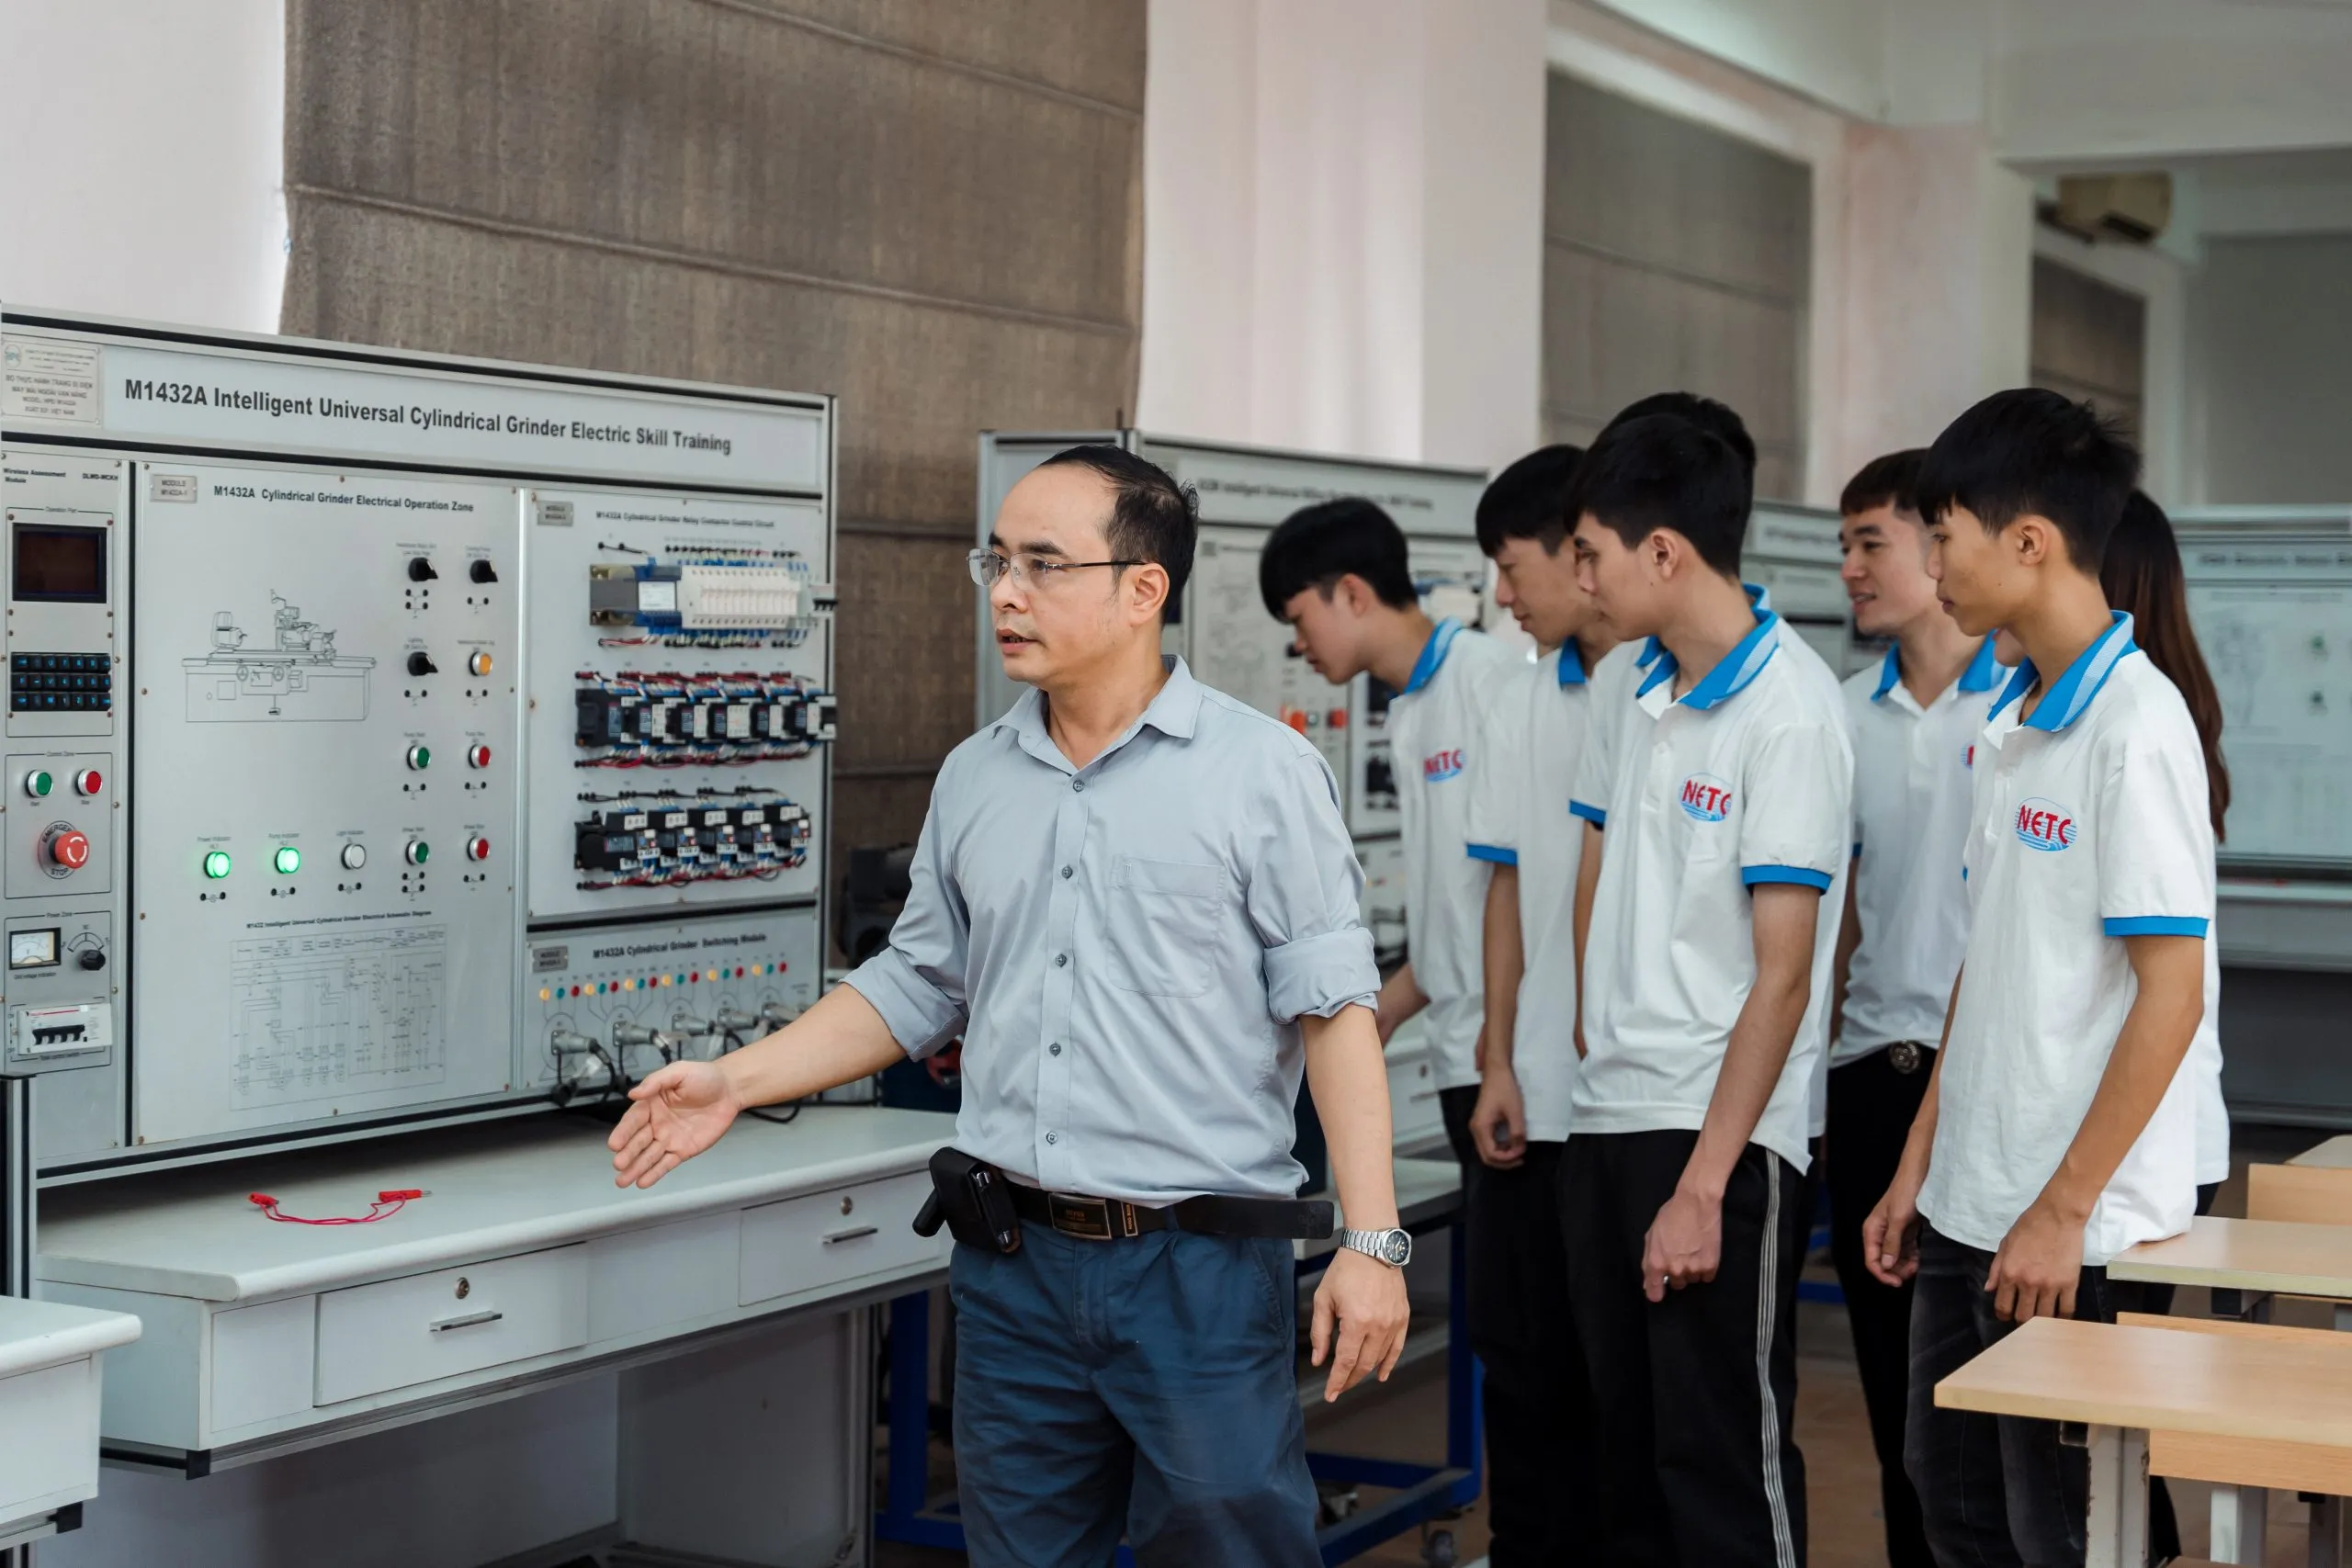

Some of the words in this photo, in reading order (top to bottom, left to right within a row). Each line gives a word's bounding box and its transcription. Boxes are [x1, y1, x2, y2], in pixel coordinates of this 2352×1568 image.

[125, 378, 208, 405] M1432A
[214, 387, 313, 417] Intelligent
[319, 397, 404, 423] Universal
[410, 406, 501, 432] Cylindrical
[506, 415, 566, 437] Grinder
[571, 421, 631, 443] Electric
[636, 427, 668, 446] Skill
[673, 431, 731, 456] Training
[3, 468, 29, 476] Wireless
[214, 485, 255, 498] M1432A
[261, 489, 314, 502] Cylindrical
[318, 491, 354, 504] Grinder
[356, 494, 401, 507] Electrical
[404, 498, 449, 511] Operation
[451, 501, 474, 512] Zone
[1681, 779, 1732, 816] NETC
[2017, 805, 2072, 845] NETC
[51, 867, 69, 875] STOP
[593, 946, 625, 958] M1432A
[627, 942, 668, 957] Cylindrical
[670, 941, 698, 951] Grinder
[702, 937, 739, 948] Switching
[740, 933, 767, 943] Module
